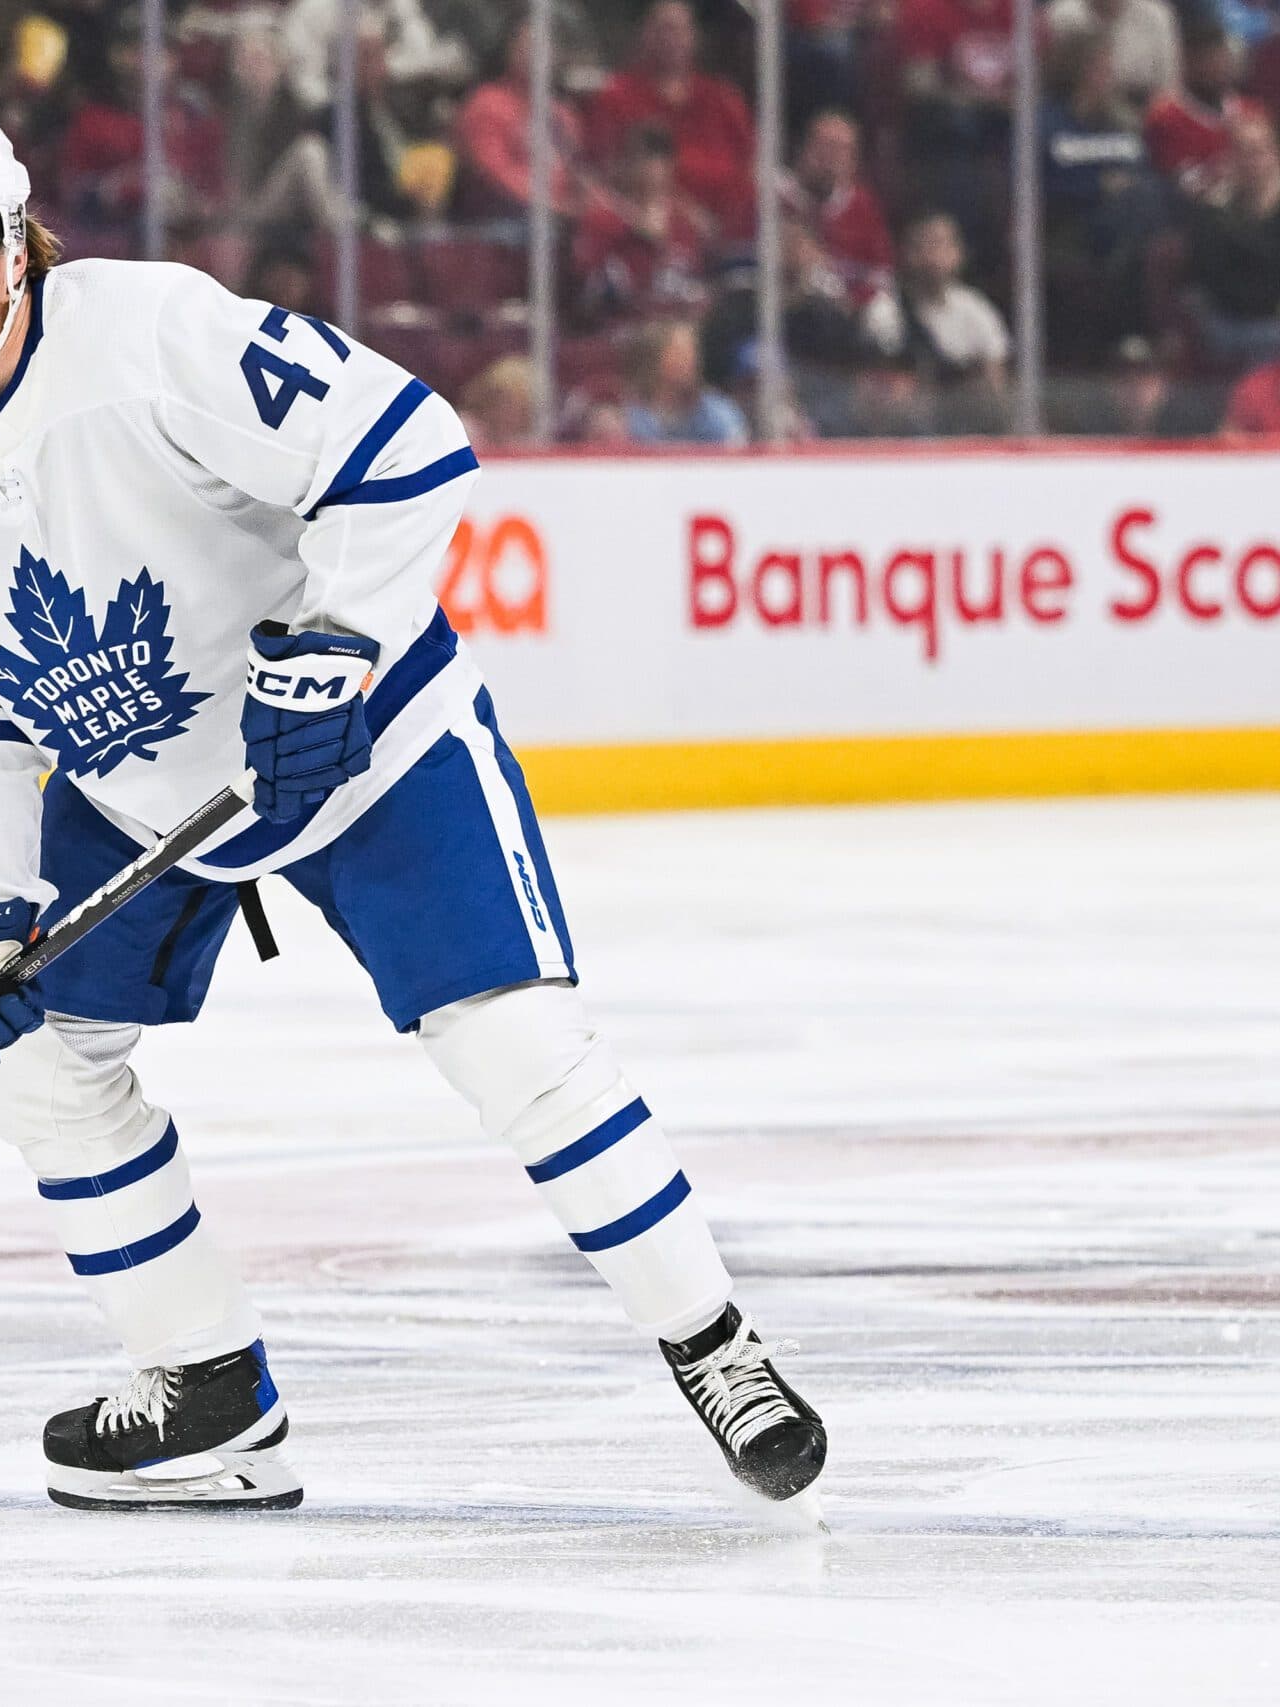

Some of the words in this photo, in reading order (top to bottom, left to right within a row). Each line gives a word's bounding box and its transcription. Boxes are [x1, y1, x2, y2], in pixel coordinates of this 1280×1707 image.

[239, 305, 351, 431] 47
[687, 512, 1076, 662] Banque
[22, 640, 151, 711] TORONTO
[52, 668, 148, 726] MAPLE
[68, 690, 163, 748] LEAFS
[513, 850, 547, 932] CCM
